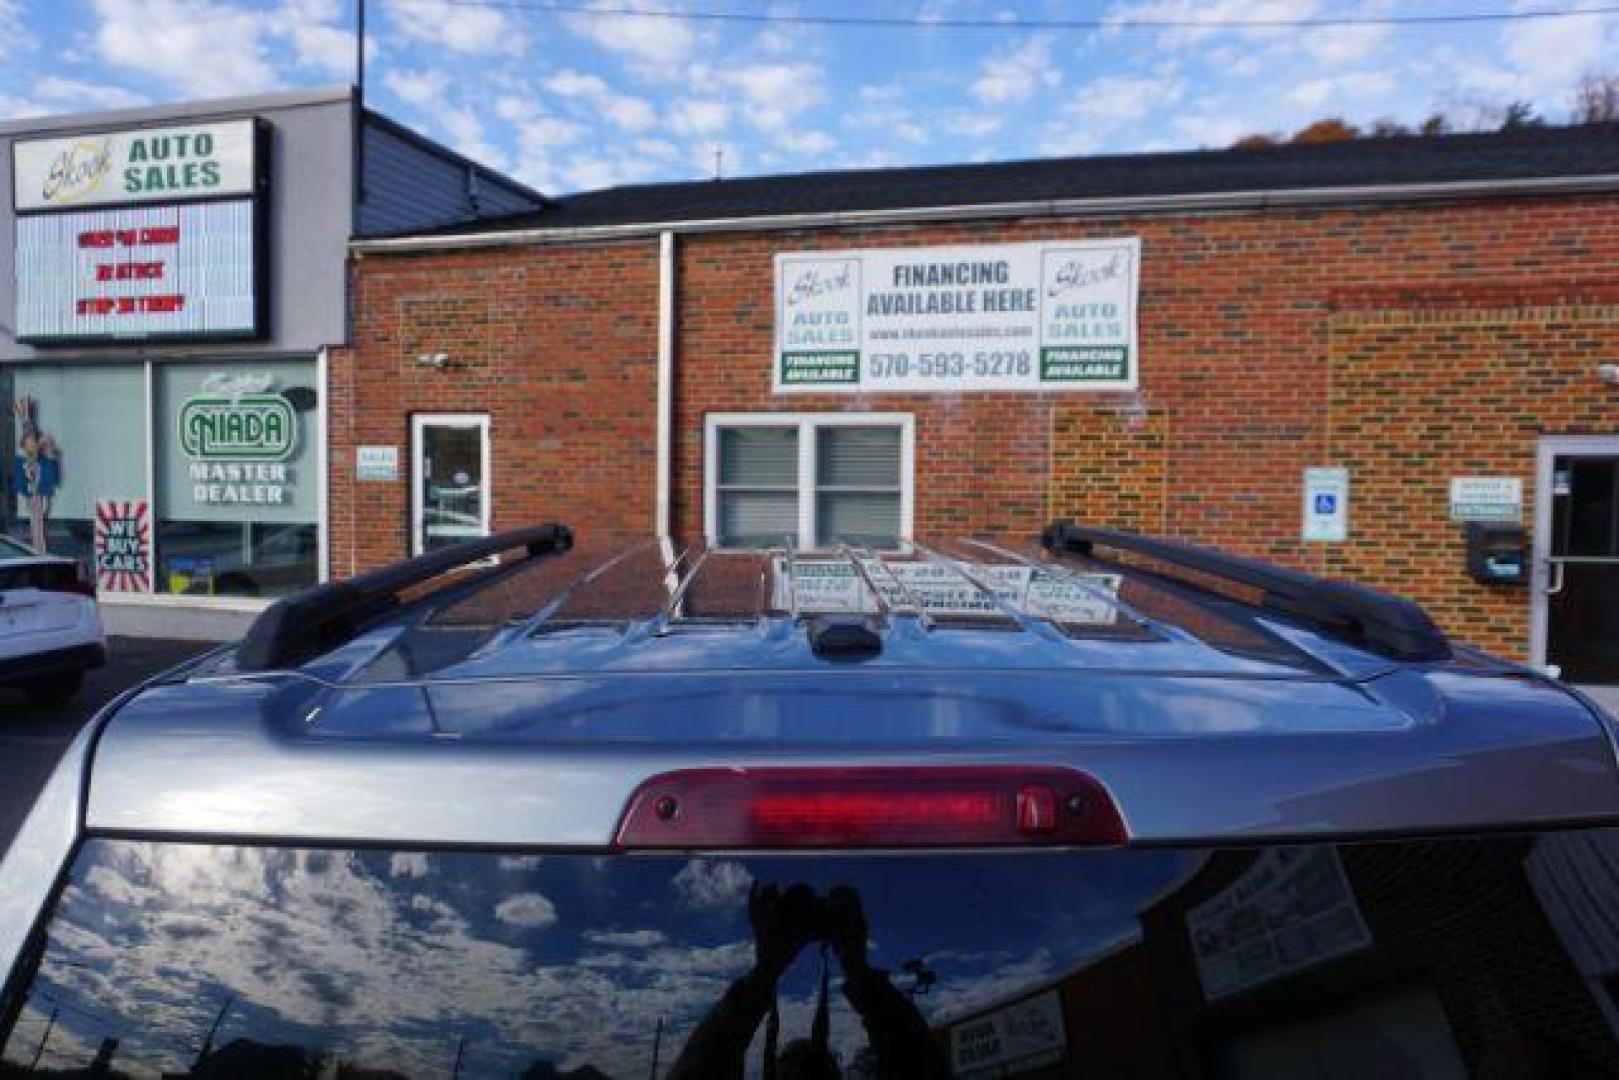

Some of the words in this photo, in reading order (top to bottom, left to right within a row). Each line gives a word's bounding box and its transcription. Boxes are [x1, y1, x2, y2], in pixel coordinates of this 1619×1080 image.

[128, 132, 214, 162] AUTO
[123, 161, 221, 193] SALES
[893, 260, 1009, 287] FINANCING
[867, 291, 976, 316] AVAILABLE
[982, 287, 1036, 313] HERE
[793, 311, 849, 325] AUTO
[1054, 303, 1118, 320] AUTO
[788, 328, 853, 345] SALES
[1048, 322, 1122, 338] SALES
[869, 350, 1031, 378] 570-593-5278
[190, 411, 282, 449] NIADA
[188, 463, 286, 481] MASTER
[193, 484, 283, 504] DEALER
[109, 520, 136, 536] WE
[108, 537, 139, 553] BUY
[102, 553, 145, 571] CARS
